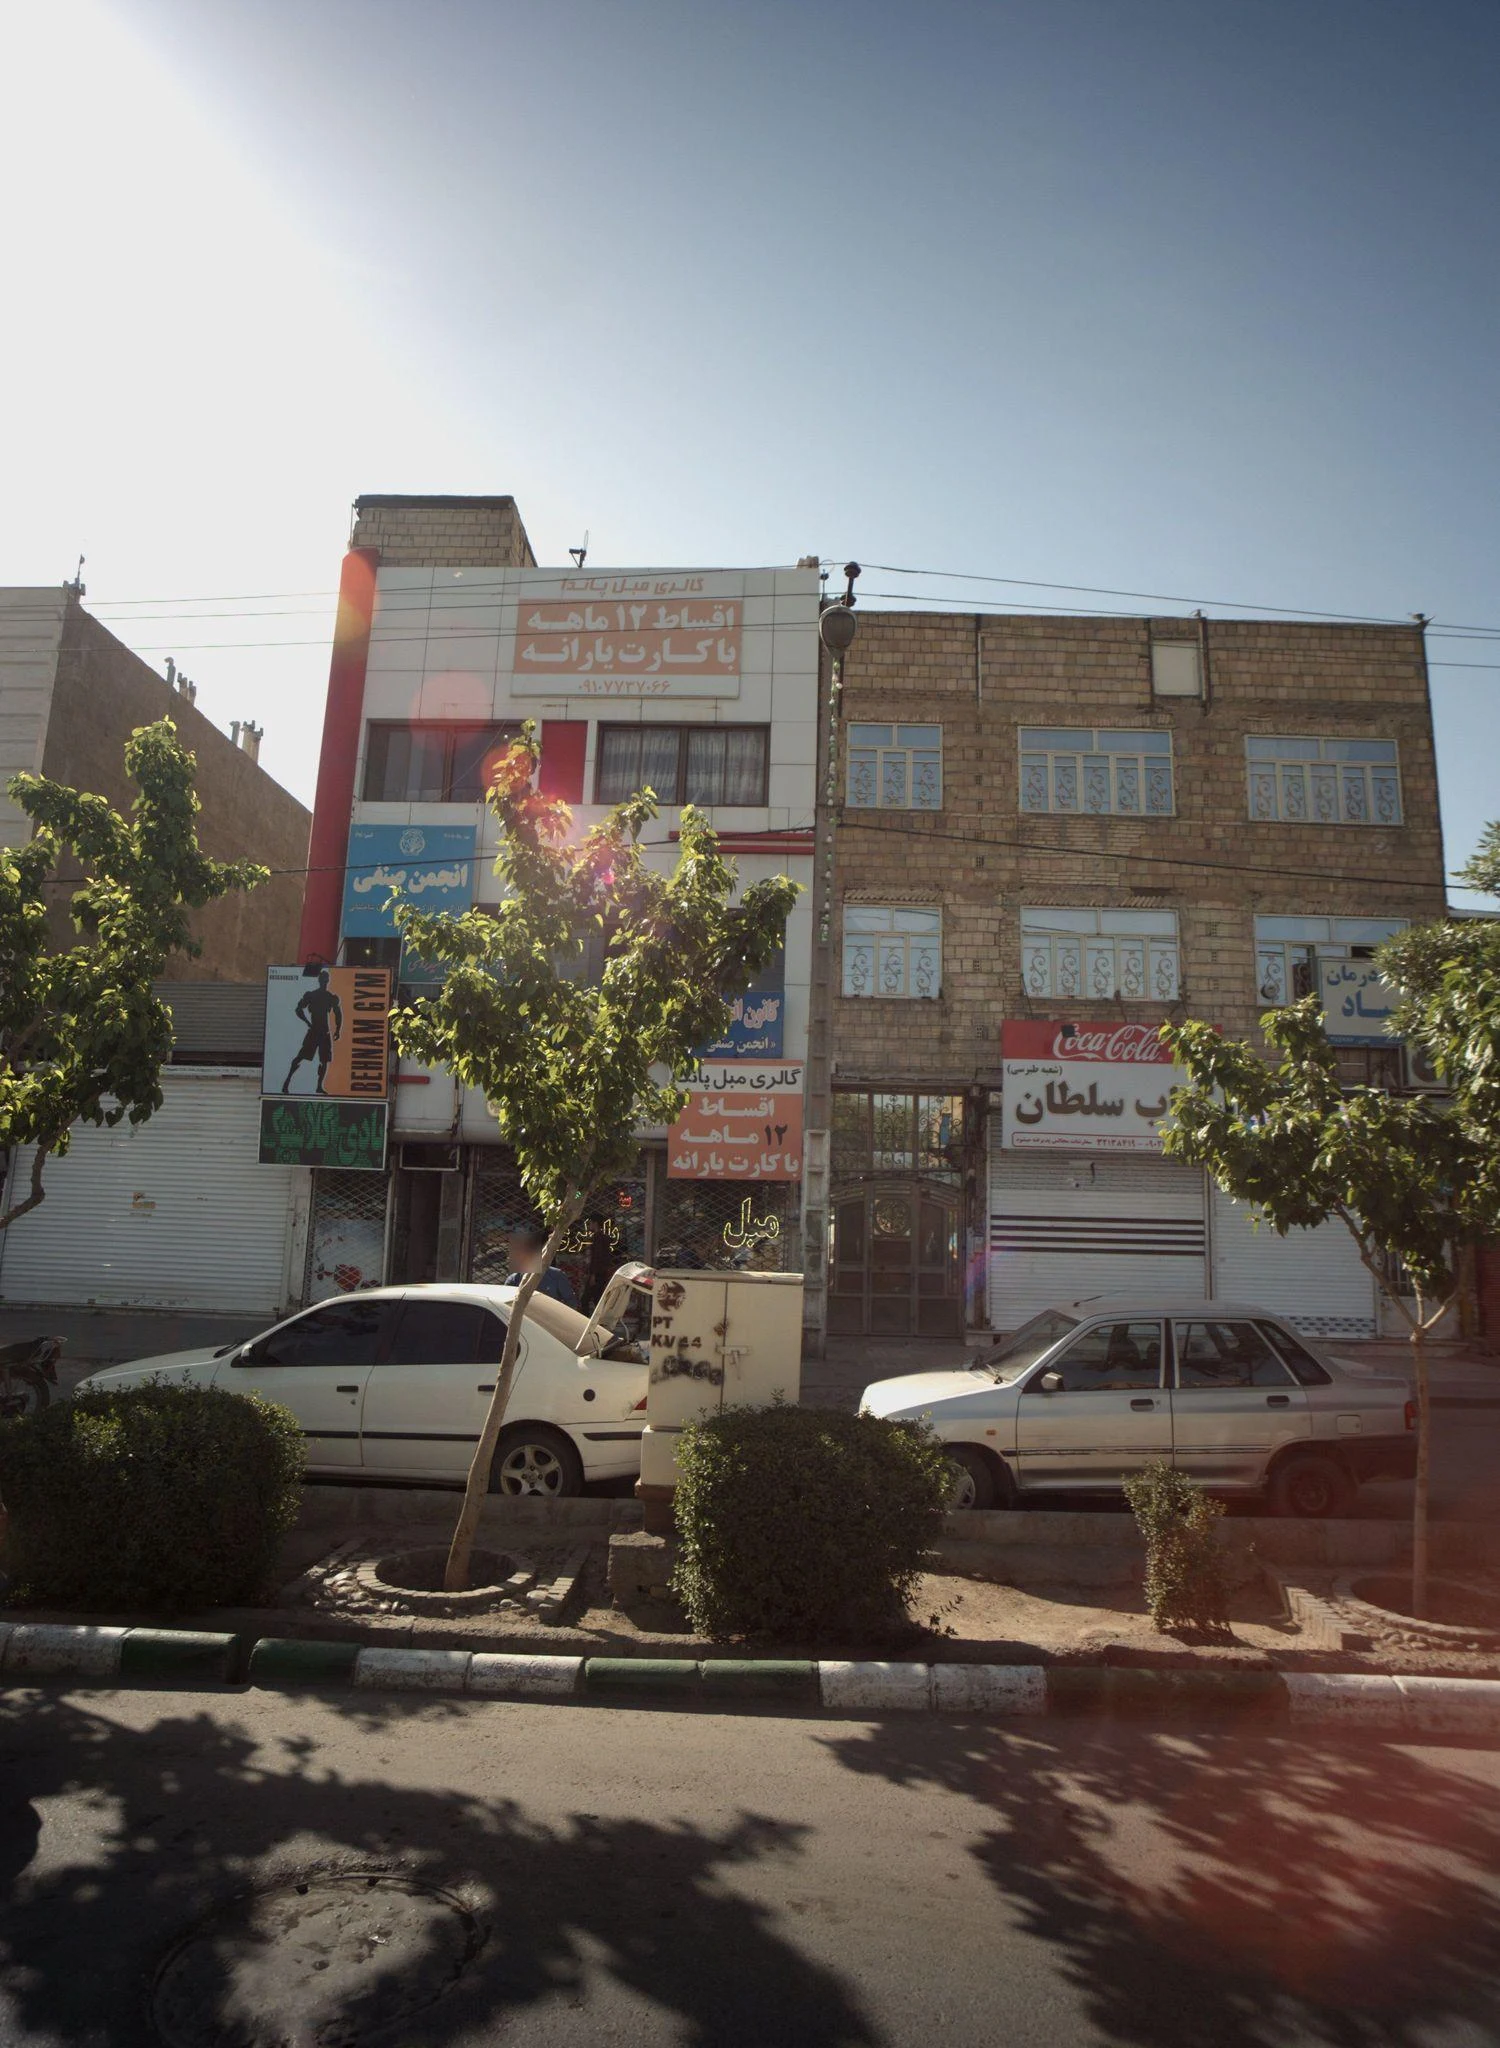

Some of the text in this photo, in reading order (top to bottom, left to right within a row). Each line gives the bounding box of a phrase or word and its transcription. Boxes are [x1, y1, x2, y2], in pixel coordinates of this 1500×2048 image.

[611, 578, 650, 596] مبل
[654, 577, 705, 595] گالری
[527, 604, 735, 632] اقساط ۱۲ ماهه
[521, 637, 614, 672] یارانه
[617, 637, 714, 672] کارت
[352, 863, 468, 893] انجمن صنفی
[350, 972, 386, 1093] BEHNAM GYM
[713, 1069, 747, 1090] مبل
[750, 1068, 801, 1089] گالری
[699, 1097, 775, 1118] اقساط
[1015, 1080, 1124, 1124] سلطان
[680, 1123, 788, 1146] ۱۲ ماهه
[673, 1151, 725, 1177] یارانه
[728, 1152, 781, 1178] کارت
[723, 1196, 780, 1249] مبل
[652, 1316, 673, 1329] PT
